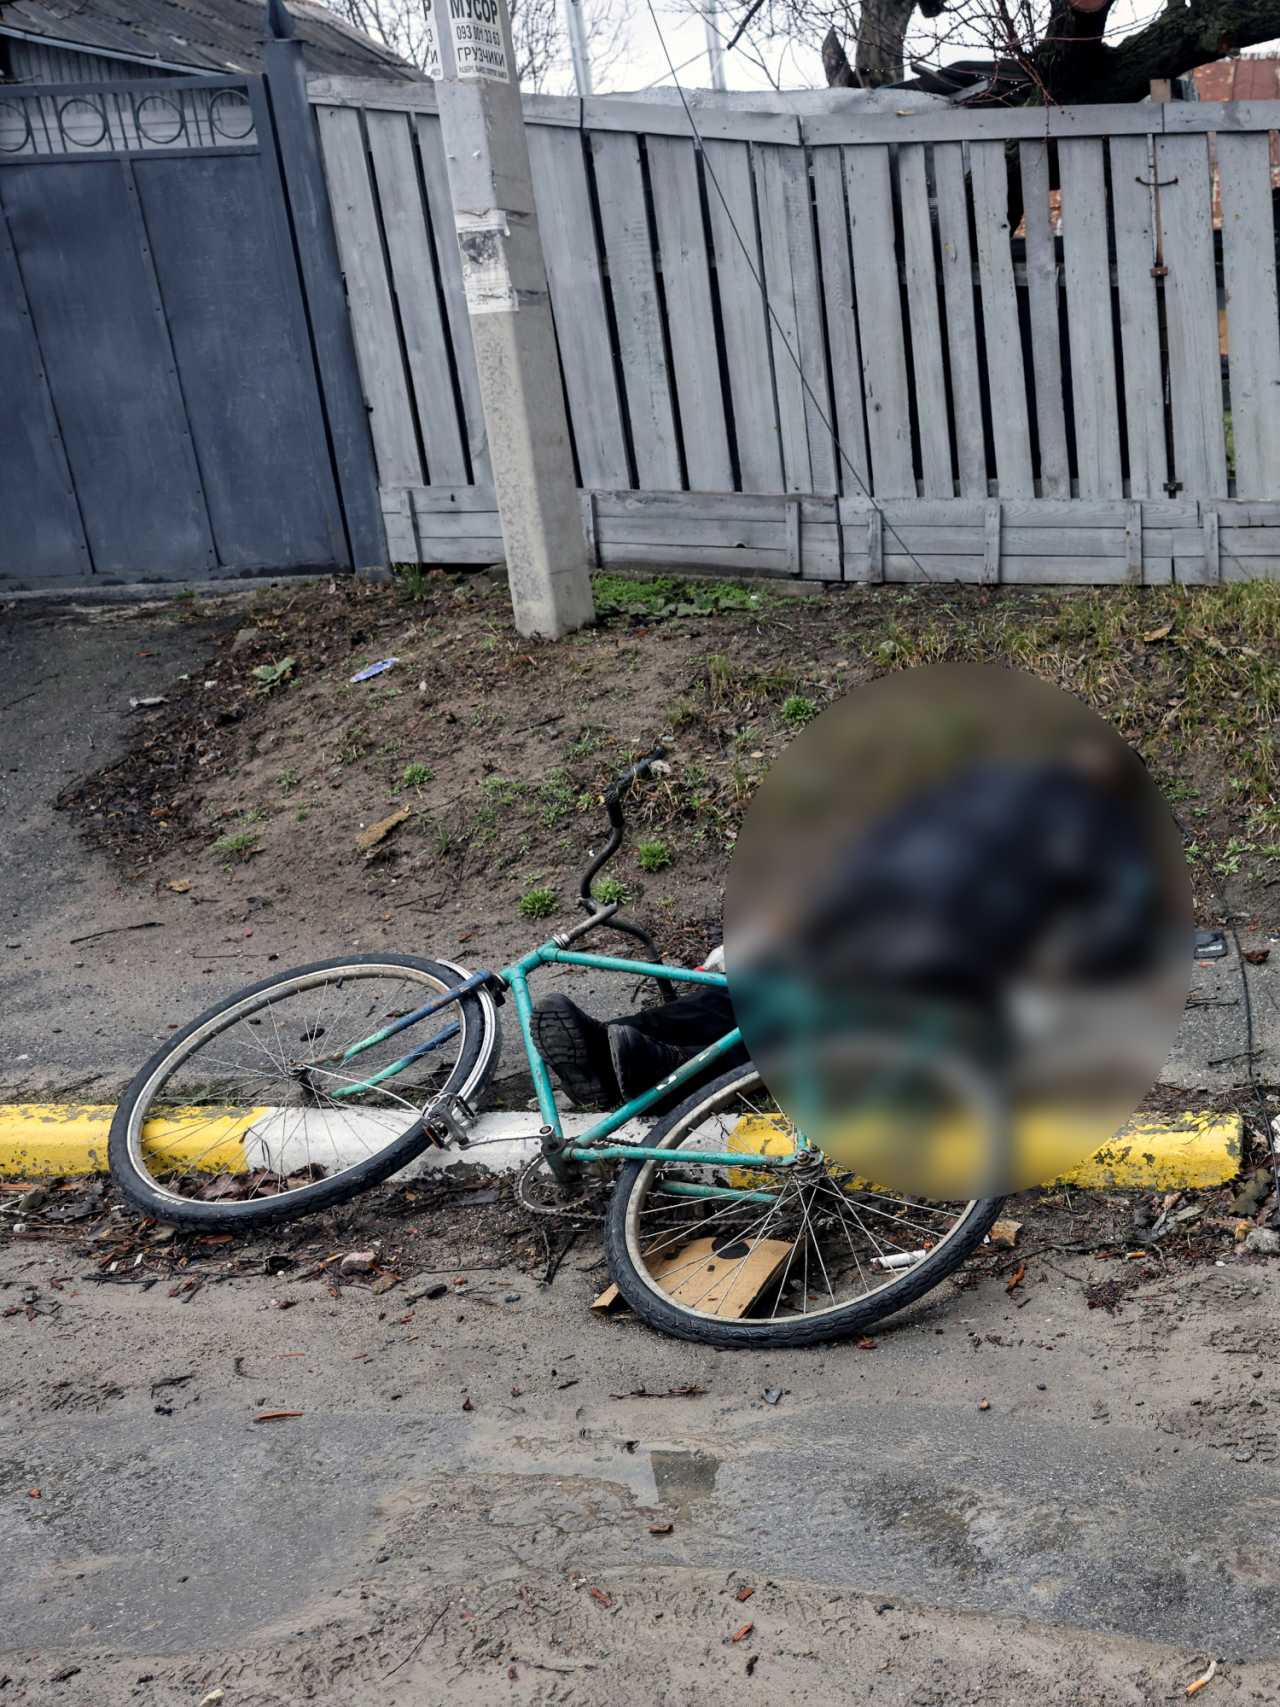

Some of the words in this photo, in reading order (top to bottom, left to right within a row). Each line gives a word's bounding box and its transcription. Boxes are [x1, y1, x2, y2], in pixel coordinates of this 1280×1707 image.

[450, 0, 498, 24] МУСОР
[456, 25, 472, 40] 093
[457, 46, 505, 67] ГРУЗЧИКИ
